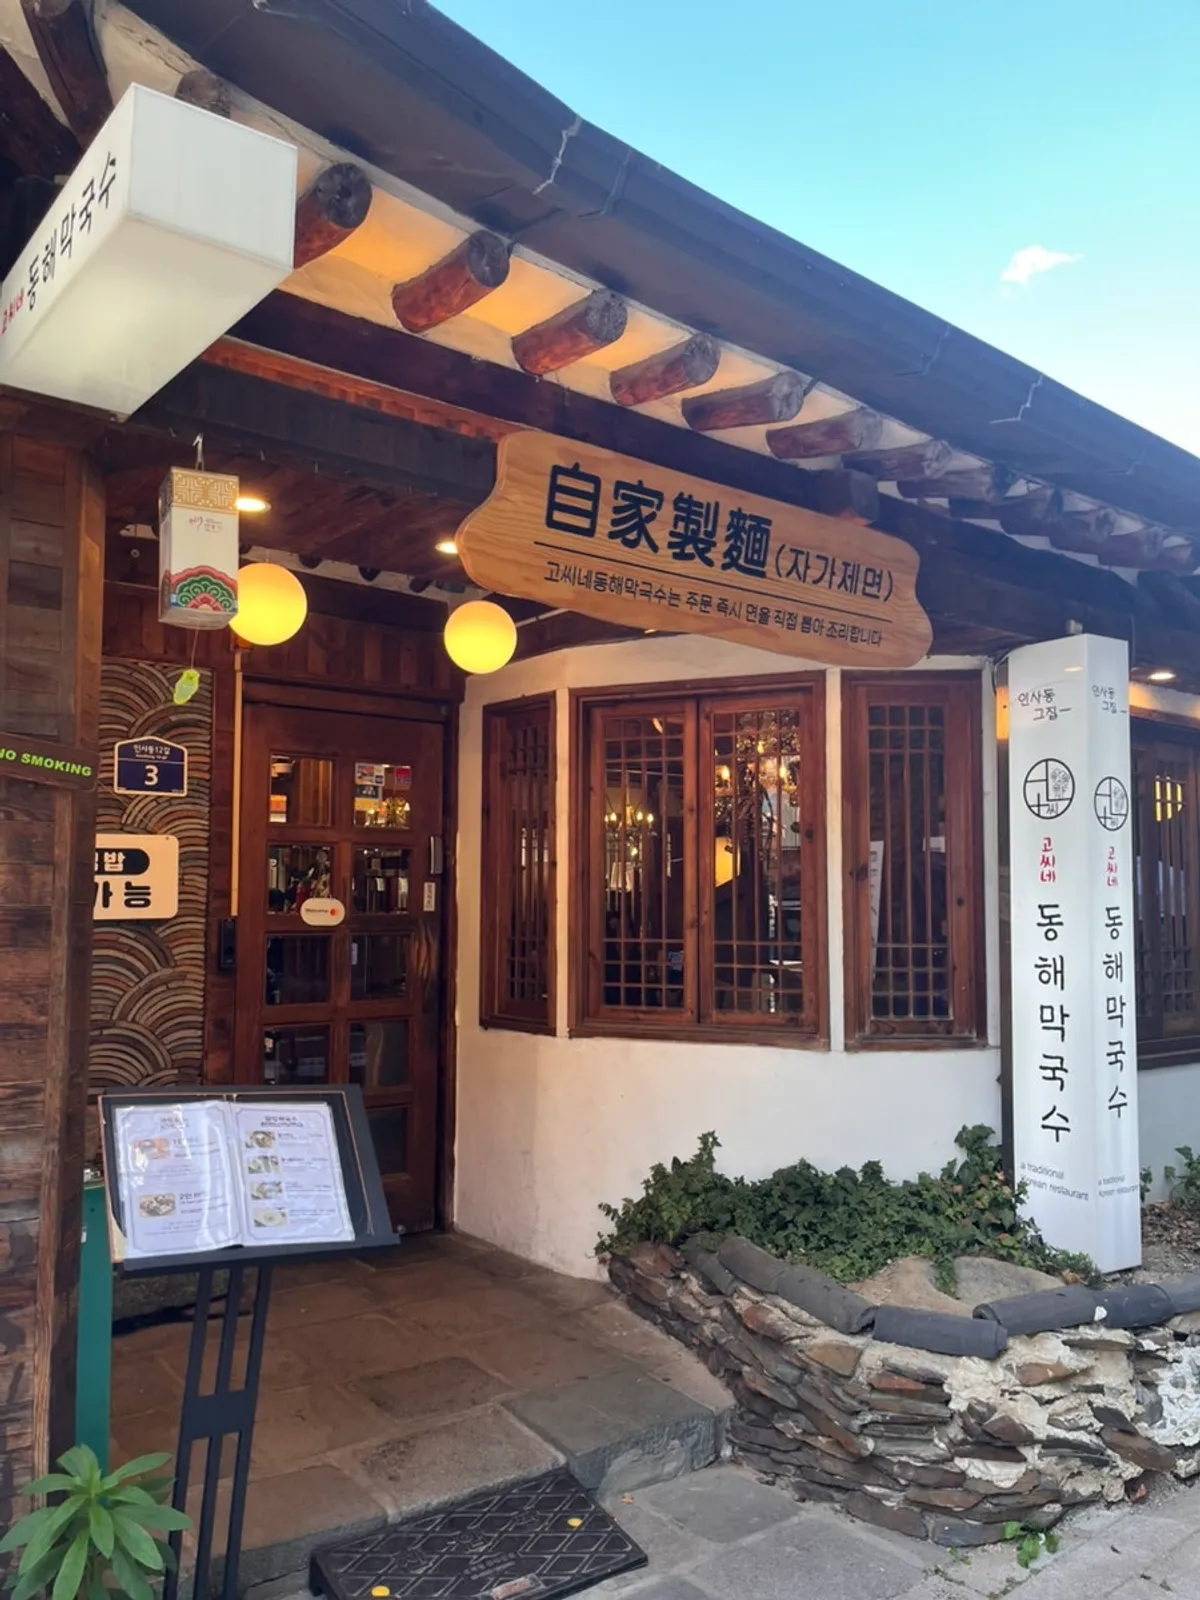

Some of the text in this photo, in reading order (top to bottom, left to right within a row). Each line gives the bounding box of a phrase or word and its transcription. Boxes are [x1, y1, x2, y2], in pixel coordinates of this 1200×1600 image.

[26, 151, 117, 311] 동해막국수
[775, 543, 894, 603] (자가제면)
[544, 561, 681, 608] 고씨네동해막국수는
[685, 590, 713, 614] 주문
[716, 597, 742, 619] 즉시
[746, 603, 771, 626] 면을
[774, 609, 798, 631] 직접
[826, 621, 883, 647] 조리합니다
[1018, 688, 1055, 707] 인사동
[1091, 685, 1116, 700] 인사동
[21, 752, 92, 777] SMOKING
[144, 764, 159, 786] 3
[94, 851, 127, 872] 밥
[1040, 836, 1057, 883] 고씨네
[1105, 845, 1119, 888] 고씨네
[1034, 903, 1072, 1144] 동해막국수
[1102, 905, 1128, 1120] 동해막국수
[1027, 1163, 1064, 1179] traditional
[1049, 1184, 1088, 1201] restaurant
